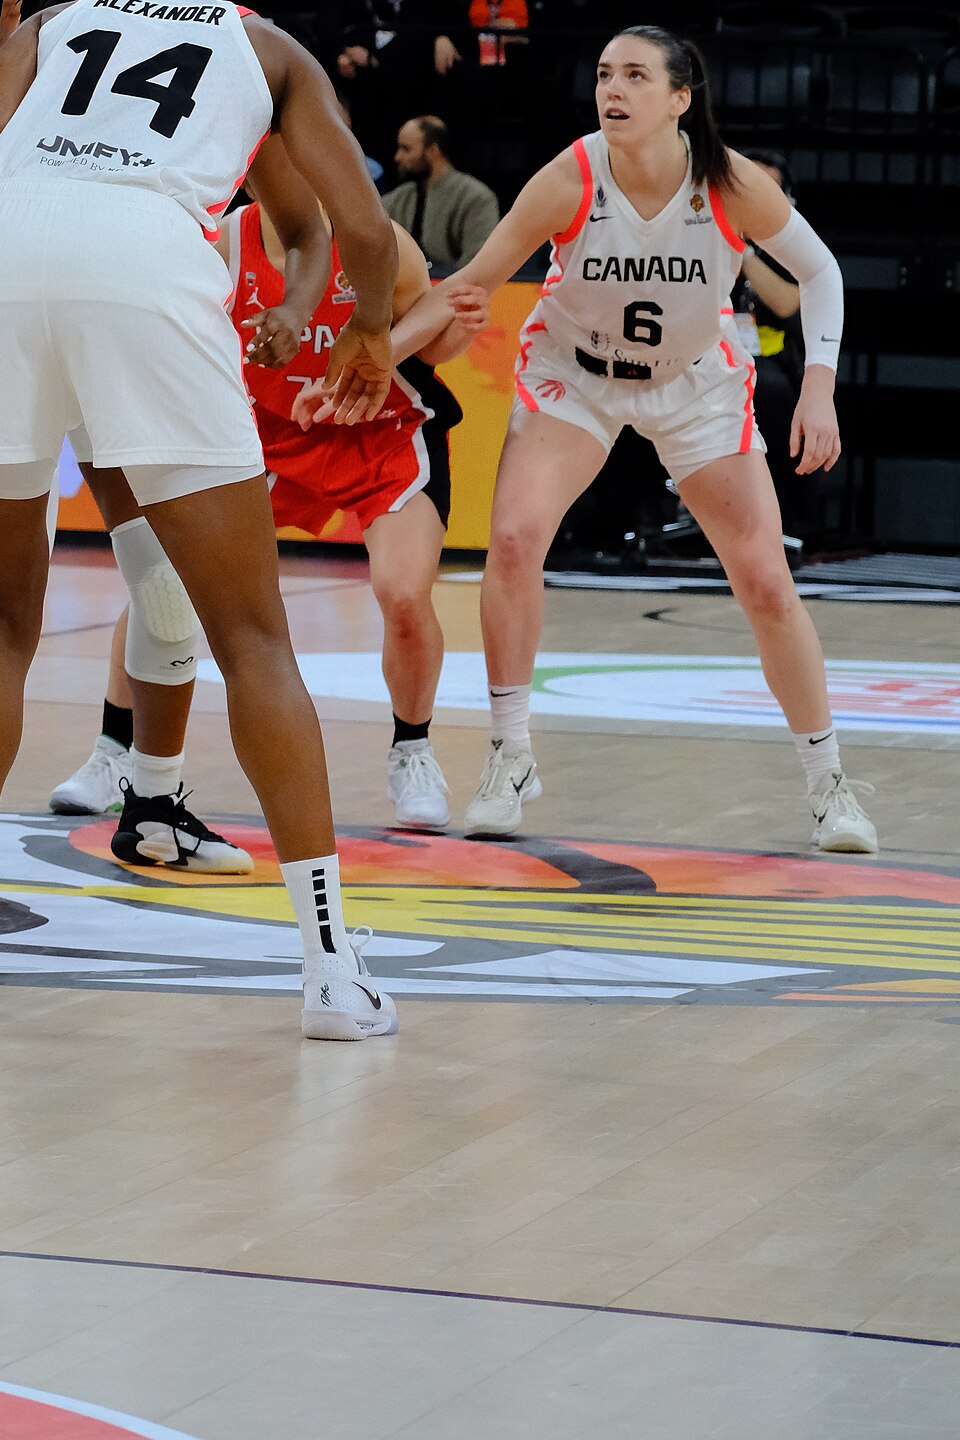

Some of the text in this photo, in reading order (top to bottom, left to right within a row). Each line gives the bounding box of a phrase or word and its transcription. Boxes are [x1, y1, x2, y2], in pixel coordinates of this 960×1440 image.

[60, 29, 213, 139] 14
[582, 256, 707, 285] CANADA
[623, 301, 663, 347] 6
